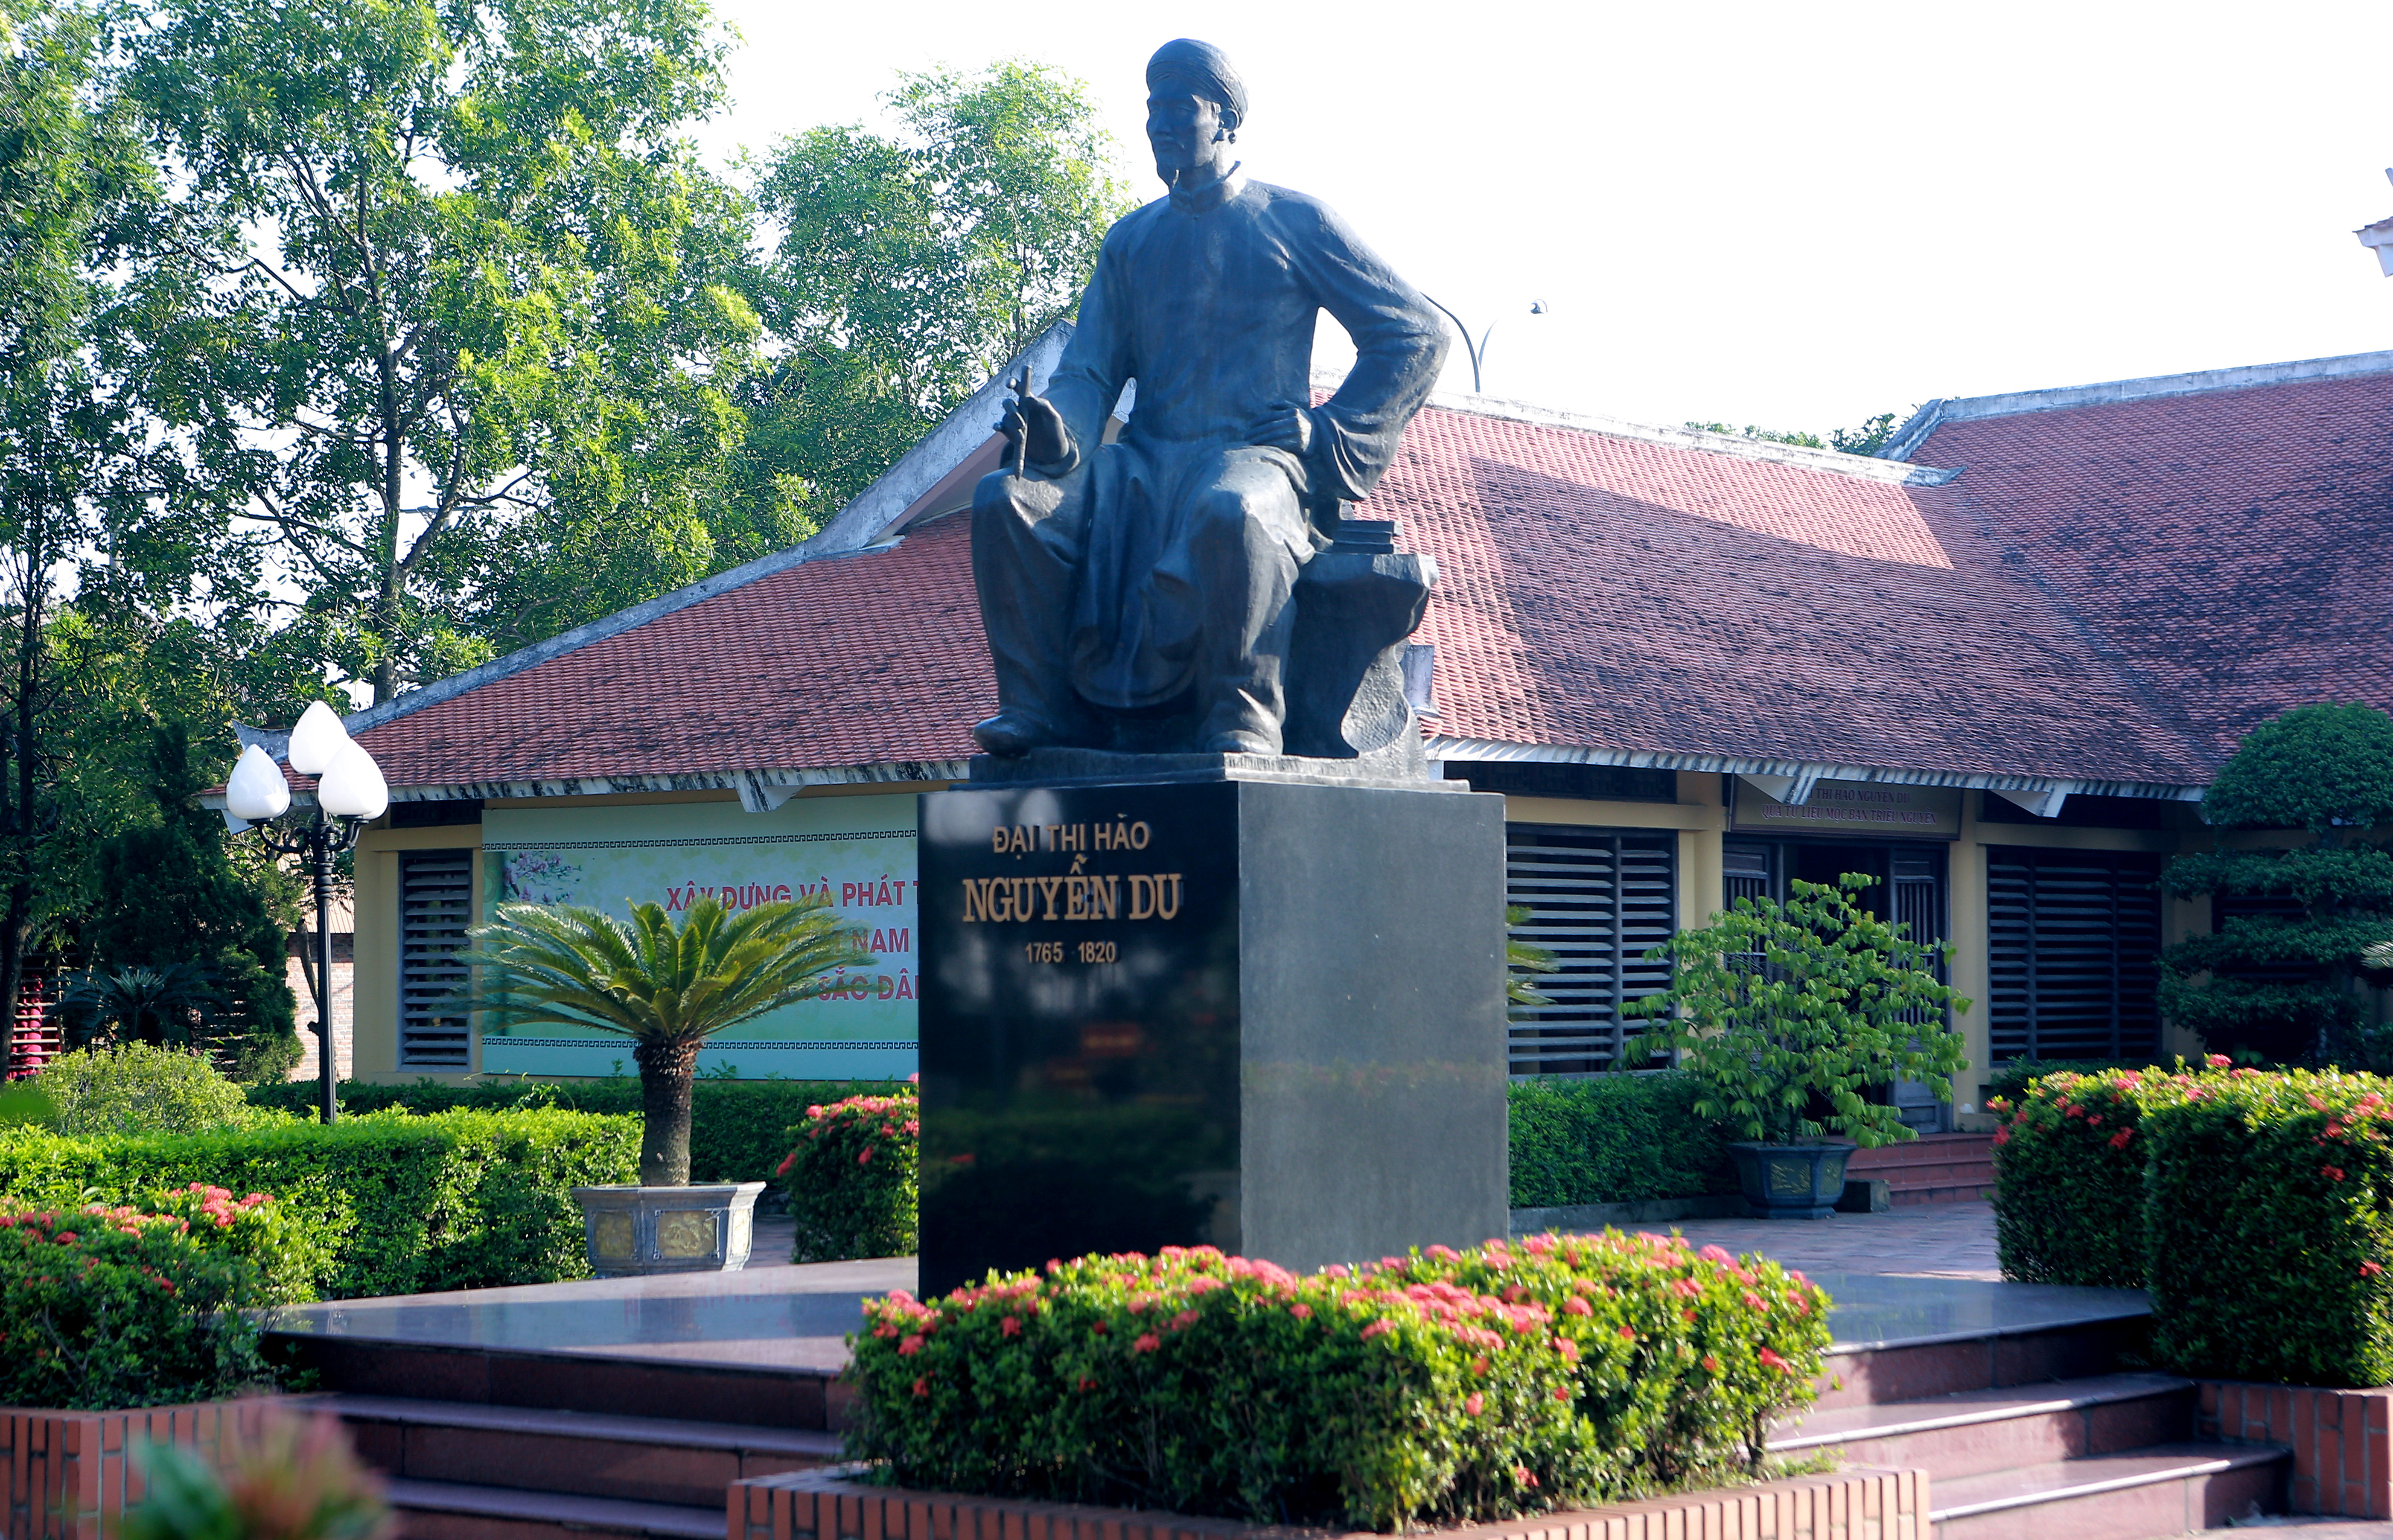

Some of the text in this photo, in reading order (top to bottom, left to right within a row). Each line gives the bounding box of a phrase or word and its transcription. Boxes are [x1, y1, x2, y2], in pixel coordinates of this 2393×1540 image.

[1816, 788, 1832, 800] THI
[1762, 804, 1782, 819] QUA
[992, 825, 1035, 860] ĐẠI
[1046, 824, 1086, 851] THI
[842, 873, 905, 907] PHÁT
[962, 853, 1119, 923] NGUYỄN
[1128, 873, 1182, 920] DU
[852, 928, 909, 953] NAM
[1026, 941, 1116, 963] 1765 1820
